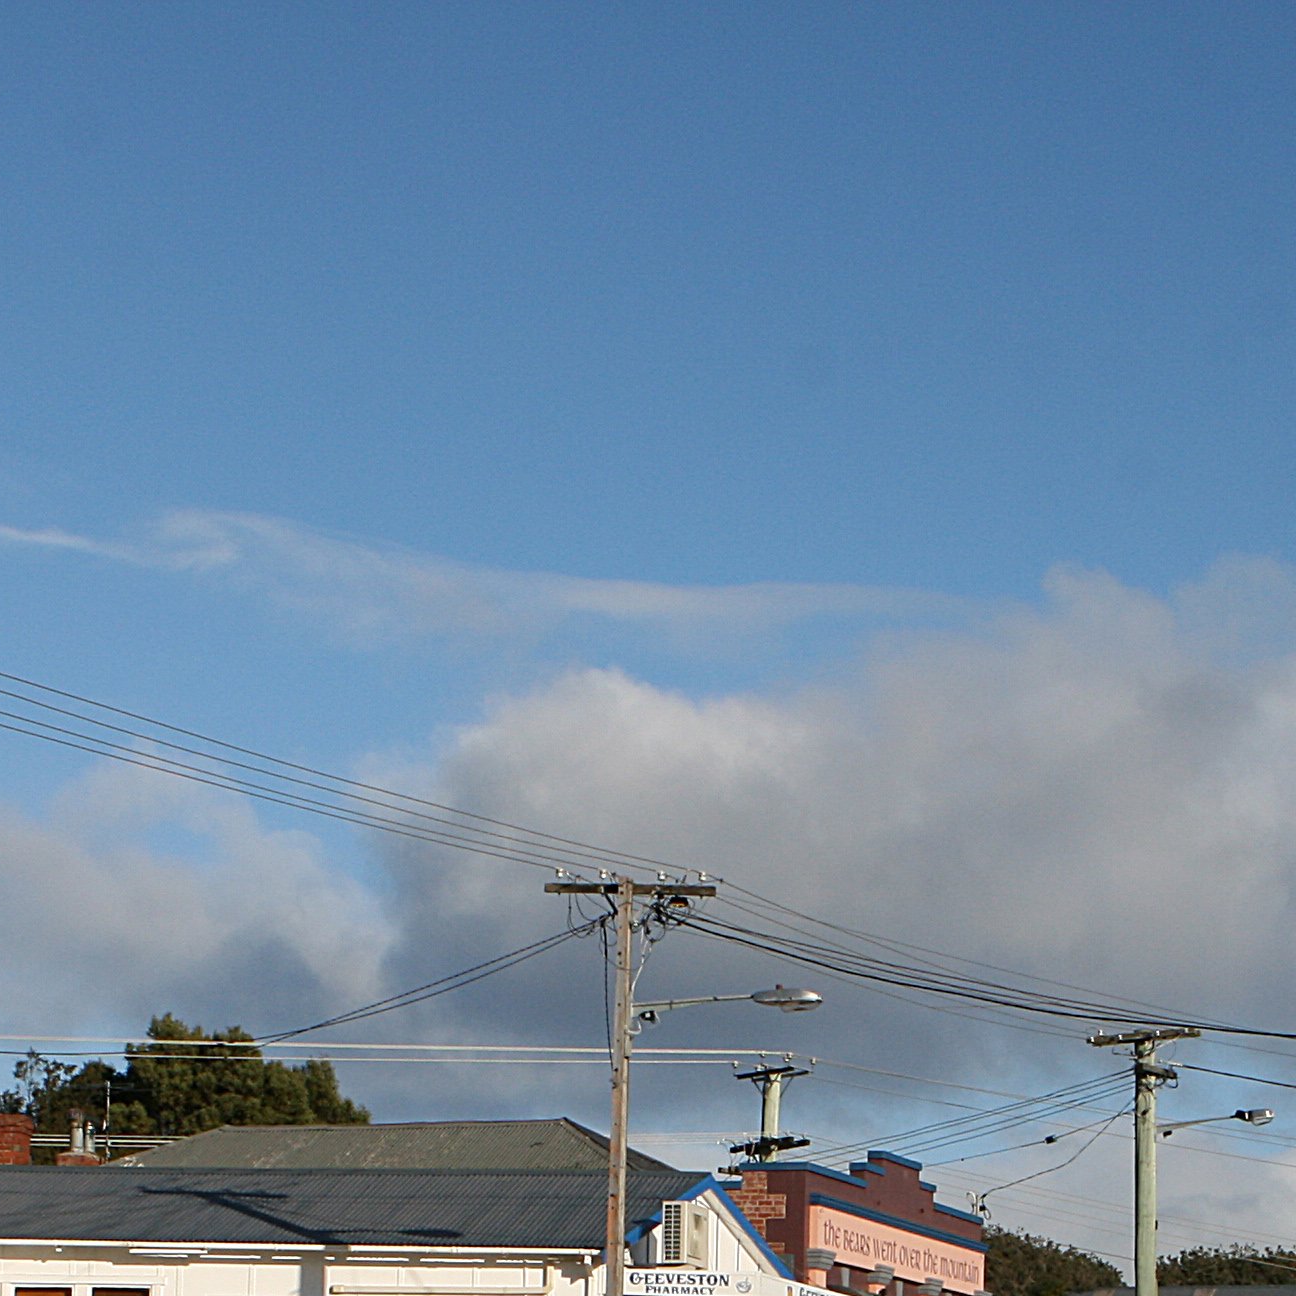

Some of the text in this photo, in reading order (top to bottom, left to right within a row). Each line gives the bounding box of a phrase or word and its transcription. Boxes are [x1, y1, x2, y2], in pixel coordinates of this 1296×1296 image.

[824, 1220, 841, 1248] the
[923, 1248, 939, 1274] the
[630, 1272, 730, 1286] GEEVESTON
[645, 1286, 716, 1295] PHARMACY
